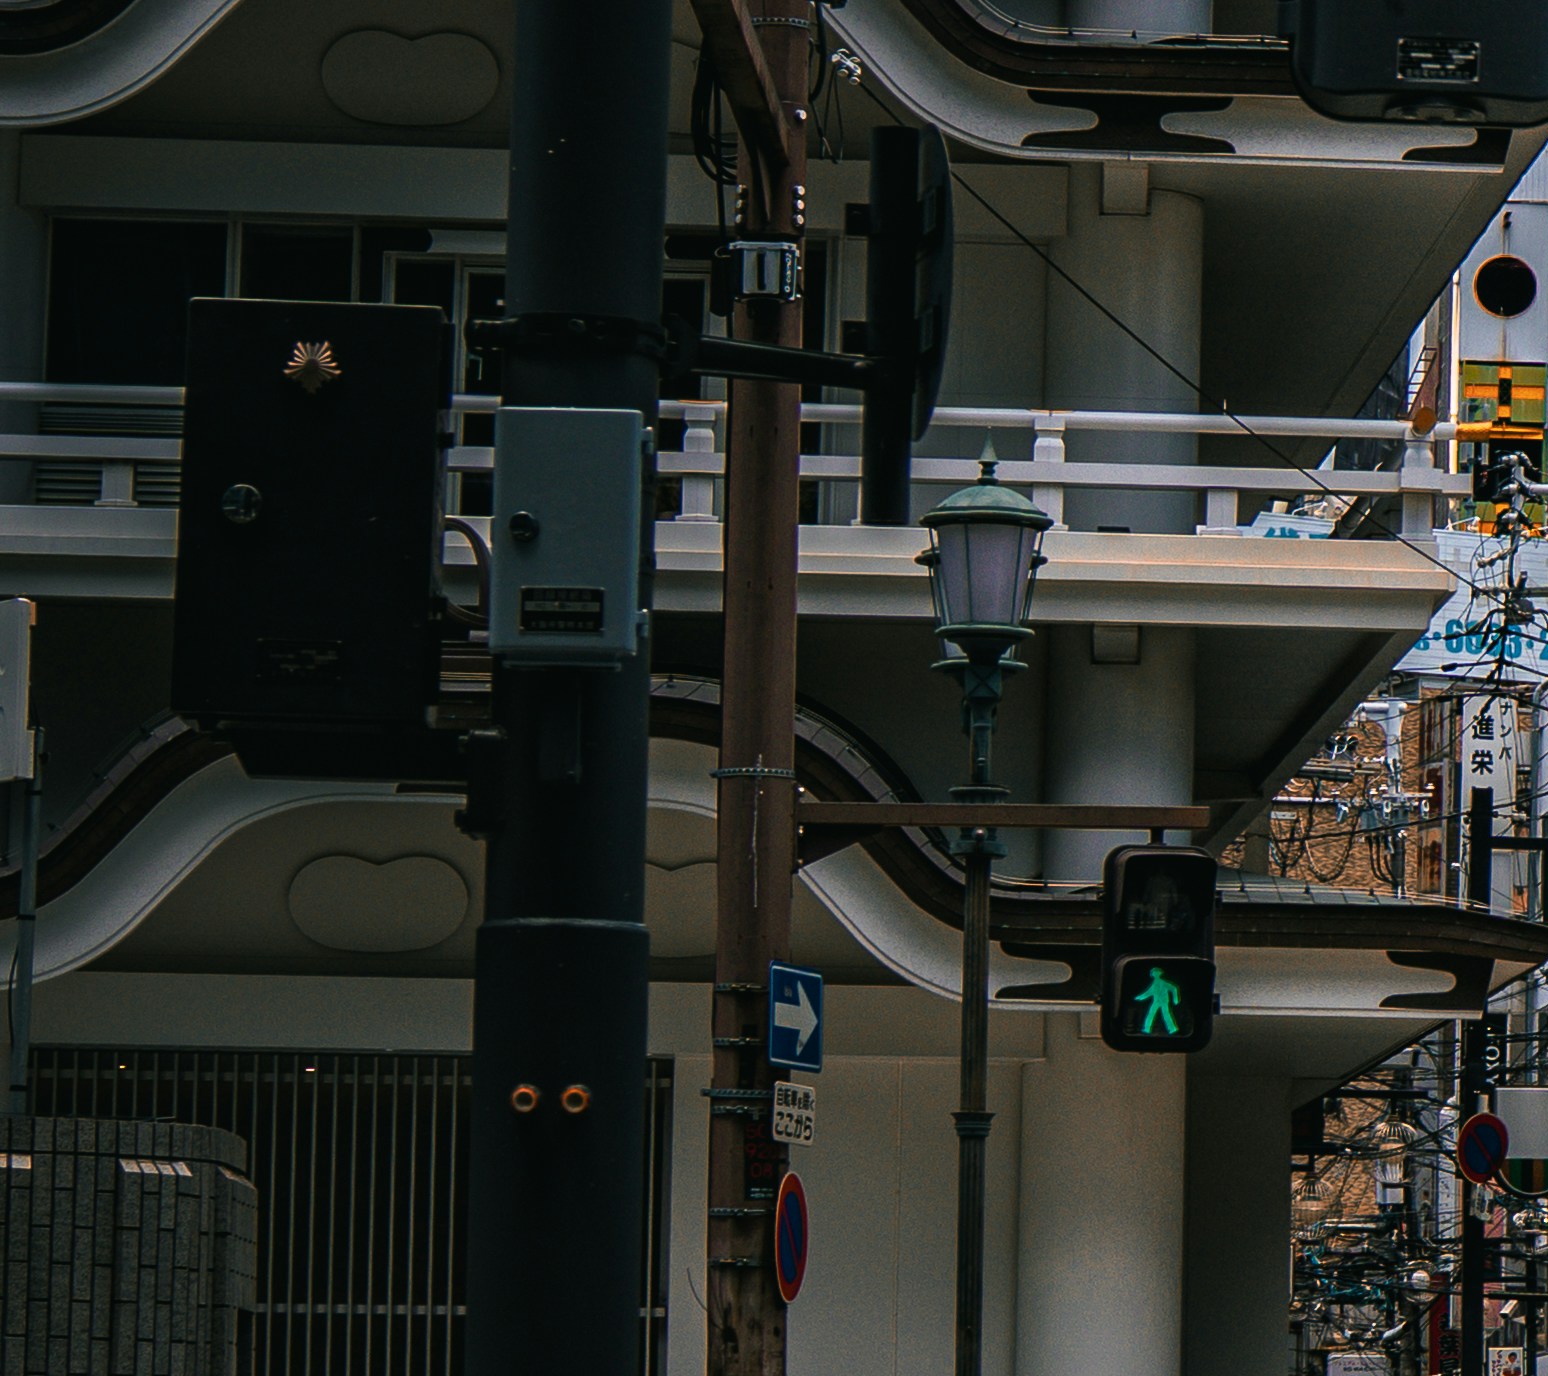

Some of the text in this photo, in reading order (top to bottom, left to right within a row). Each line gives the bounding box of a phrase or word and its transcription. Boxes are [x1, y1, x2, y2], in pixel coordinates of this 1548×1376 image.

[1471, 714, 1495, 776] 進栄
[1499, 703, 1513, 761] ナンバ
[774, 1111, 813, 1141] ここから
